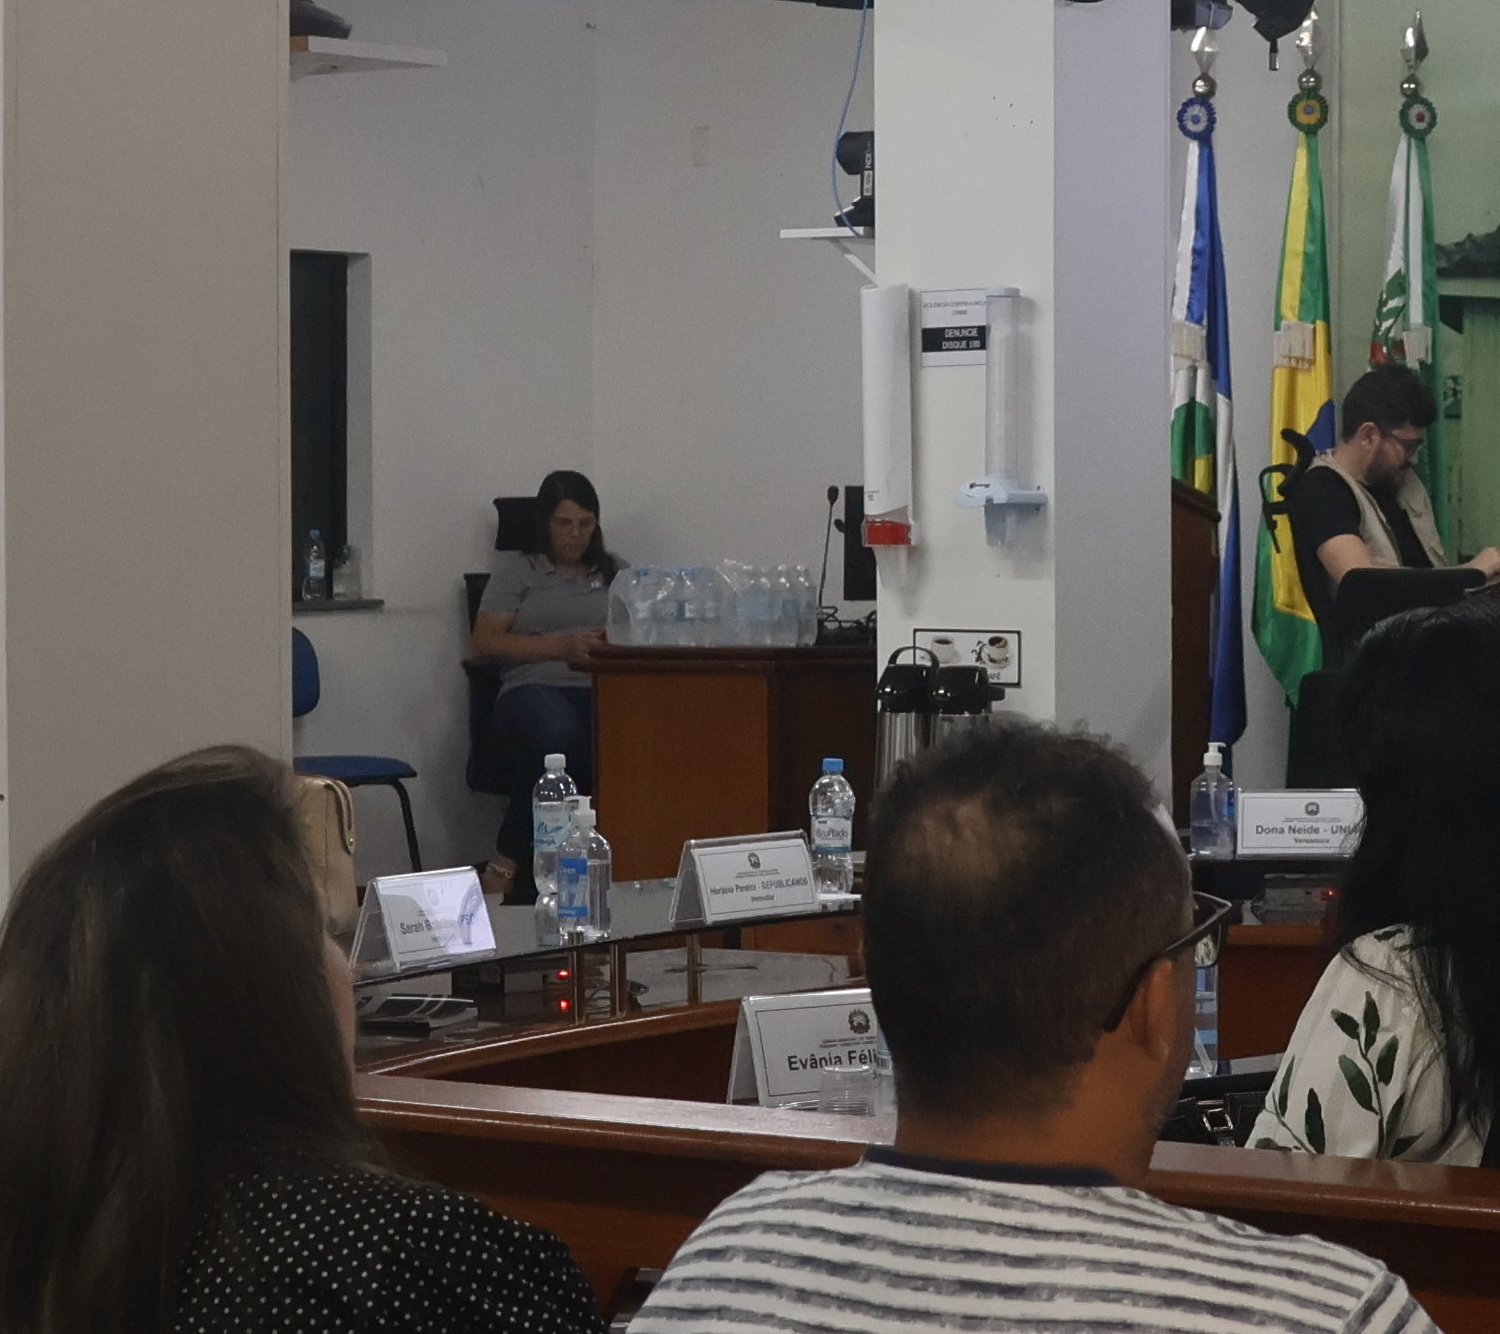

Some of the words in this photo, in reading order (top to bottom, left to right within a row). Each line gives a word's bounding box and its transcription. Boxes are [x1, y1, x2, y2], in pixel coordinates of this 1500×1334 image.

[1256, 825, 1285, 835] Dona
[1288, 825, 1320, 835] Neide
[761, 877, 808, 889] REPUBLICANOS
[400, 921, 424, 935] Sarah
[788, 1053, 842, 1071] Evânia
[848, 1049, 877, 1065] Féli
